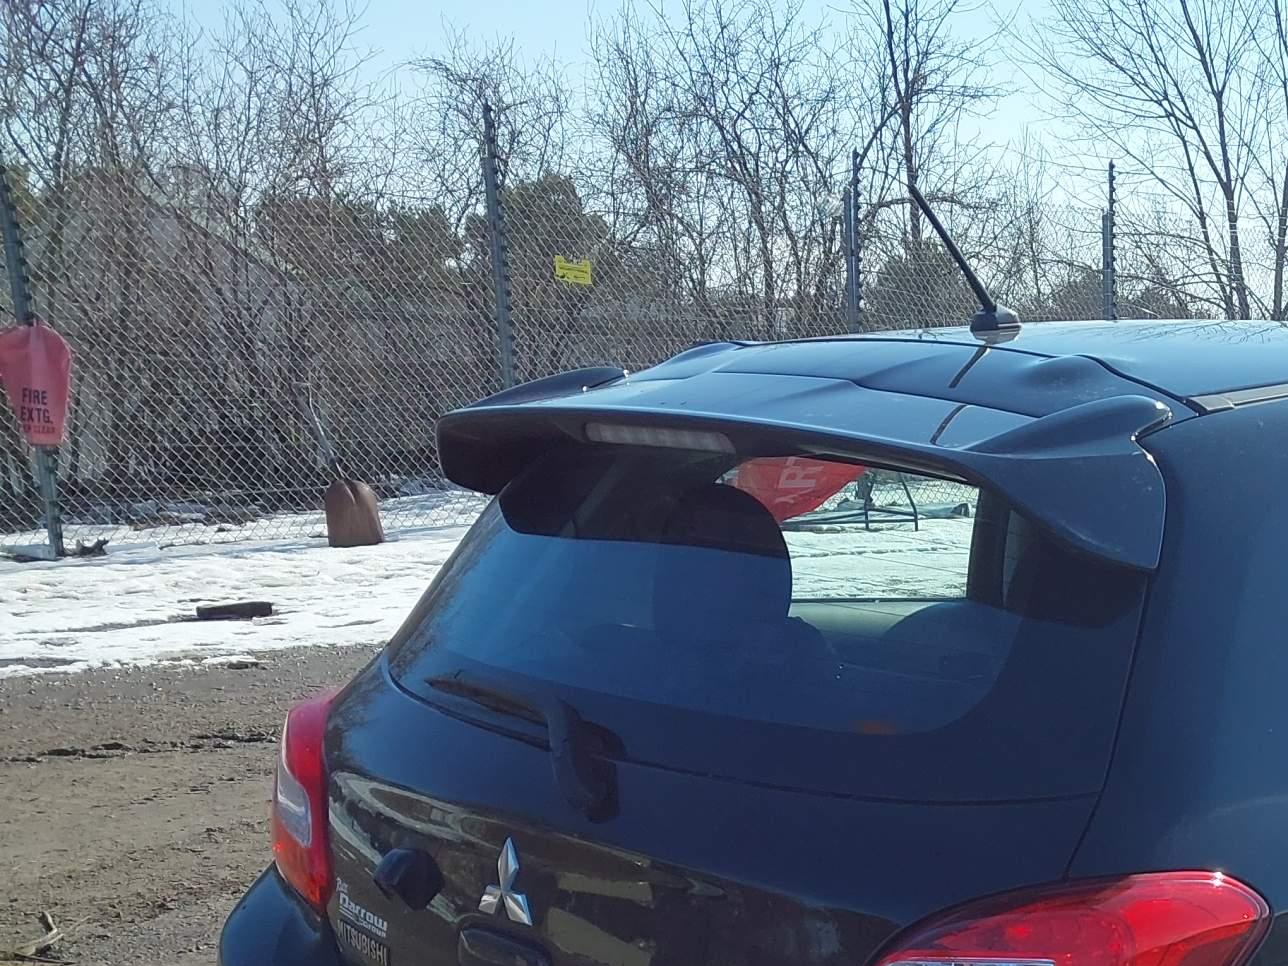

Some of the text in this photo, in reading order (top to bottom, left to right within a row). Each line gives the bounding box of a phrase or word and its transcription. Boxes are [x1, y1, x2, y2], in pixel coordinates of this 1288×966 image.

[22, 387, 48, 405] FIRE
[339, 892, 388, 931] Darrow
[337, 919, 388, 966] MITSUBISHI
